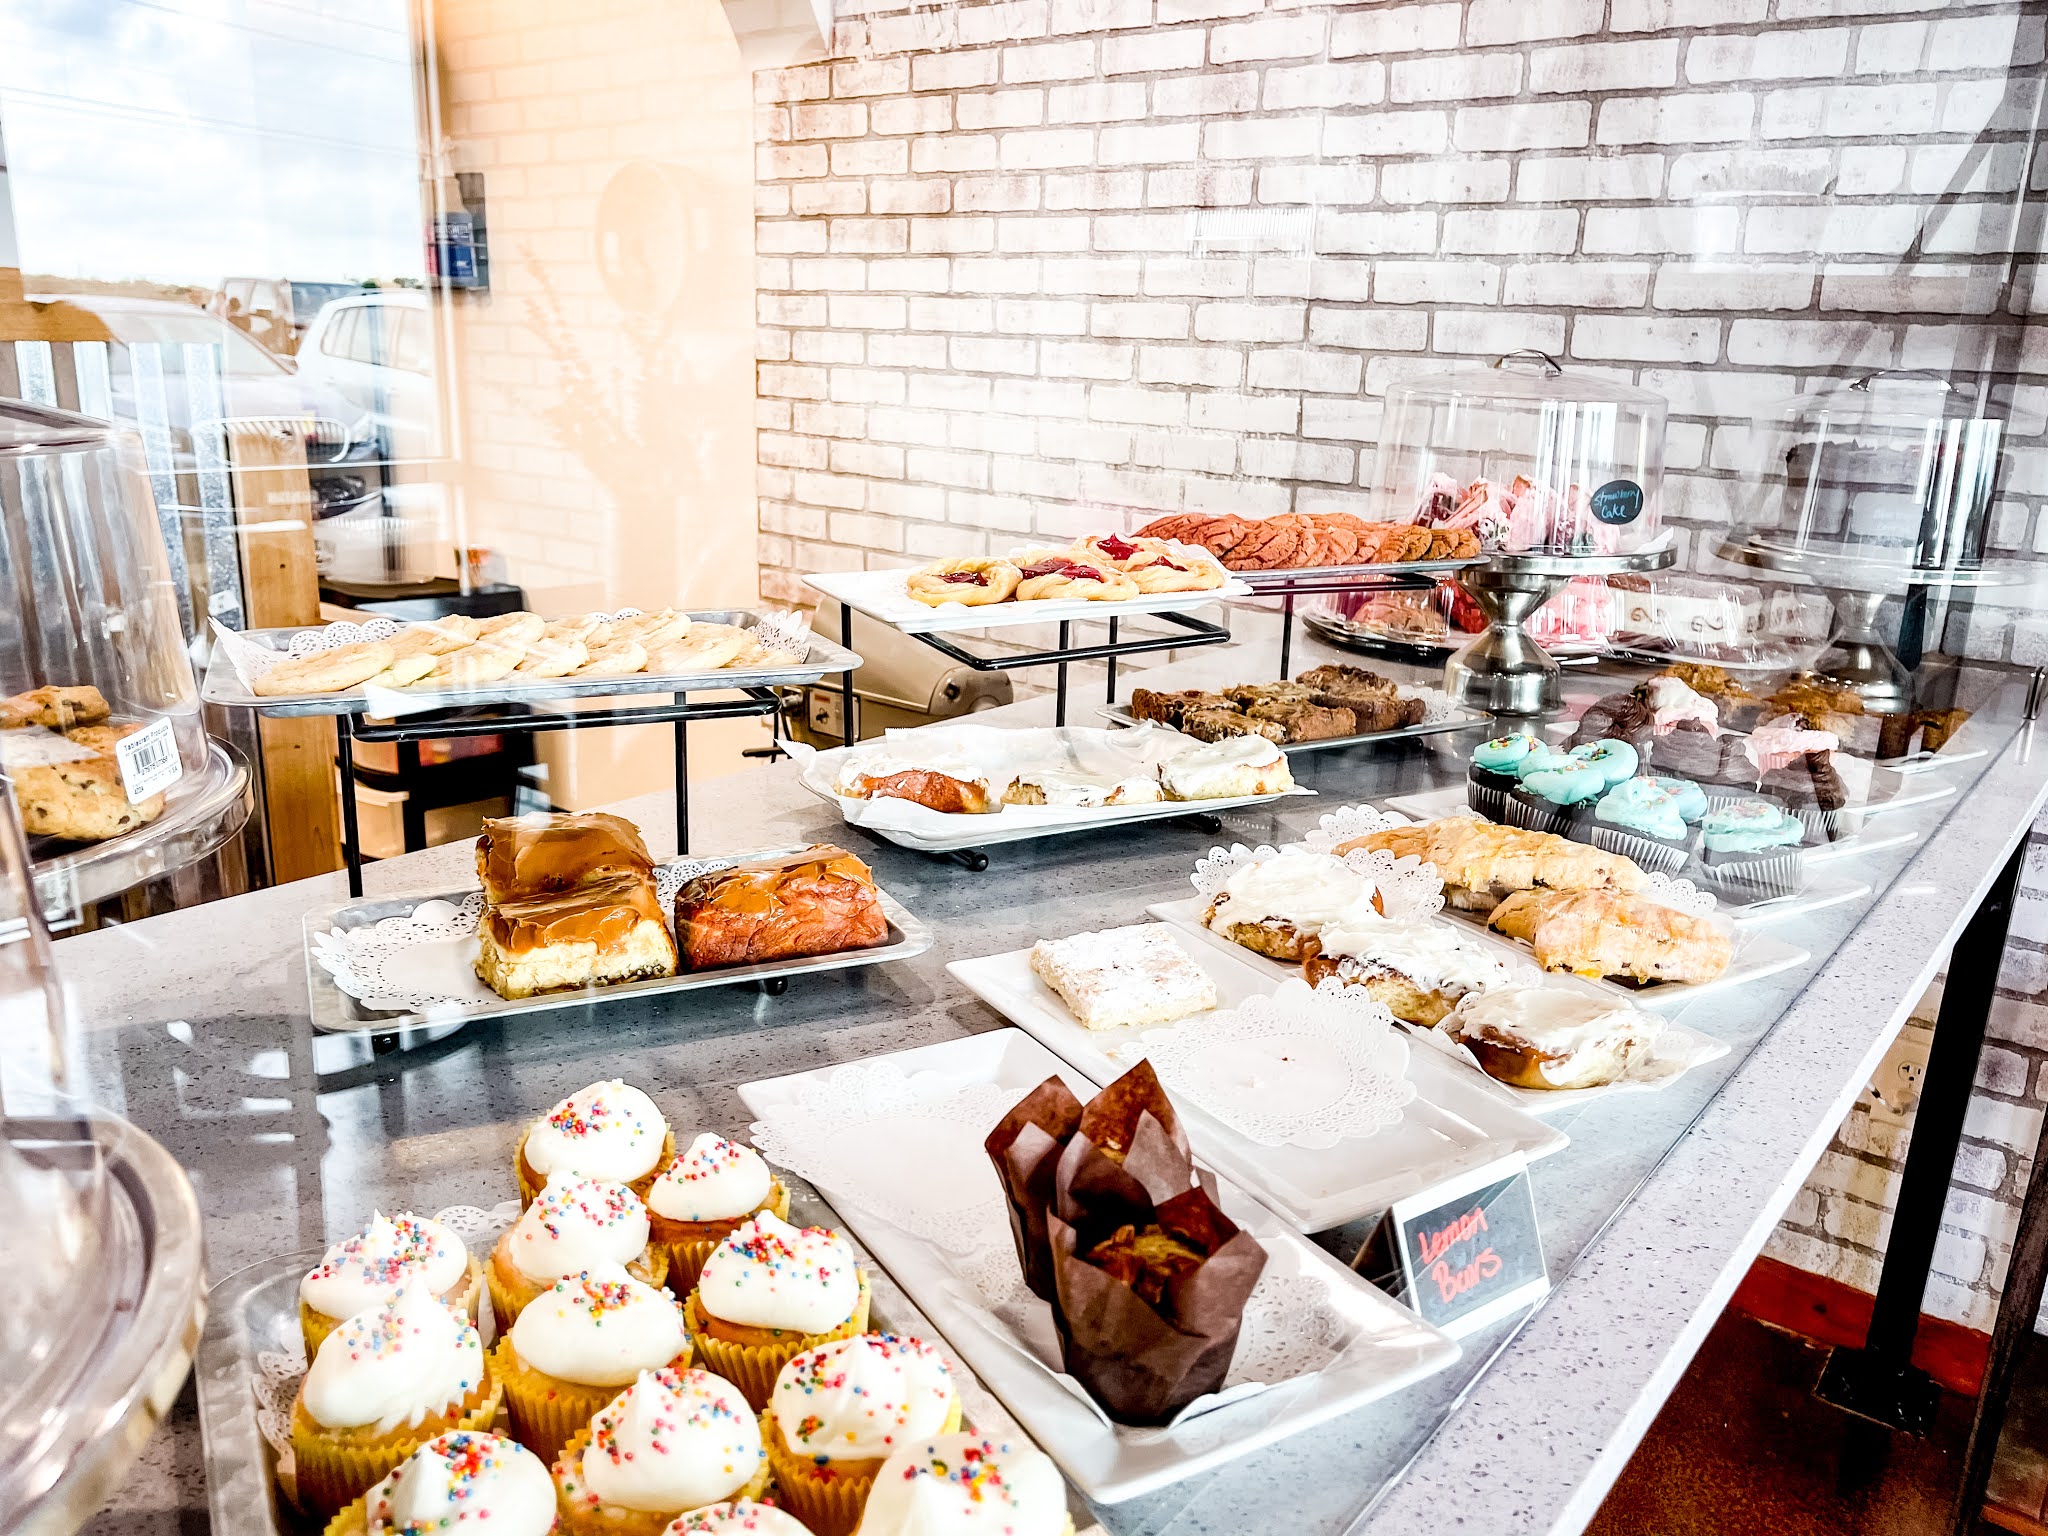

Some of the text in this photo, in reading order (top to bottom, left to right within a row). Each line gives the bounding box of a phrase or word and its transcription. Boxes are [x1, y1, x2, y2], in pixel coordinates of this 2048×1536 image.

[1601, 504, 1627, 519] Cake
[1418, 1207, 1489, 1265] Lemon
[1432, 1247, 1503, 1304] Bars
